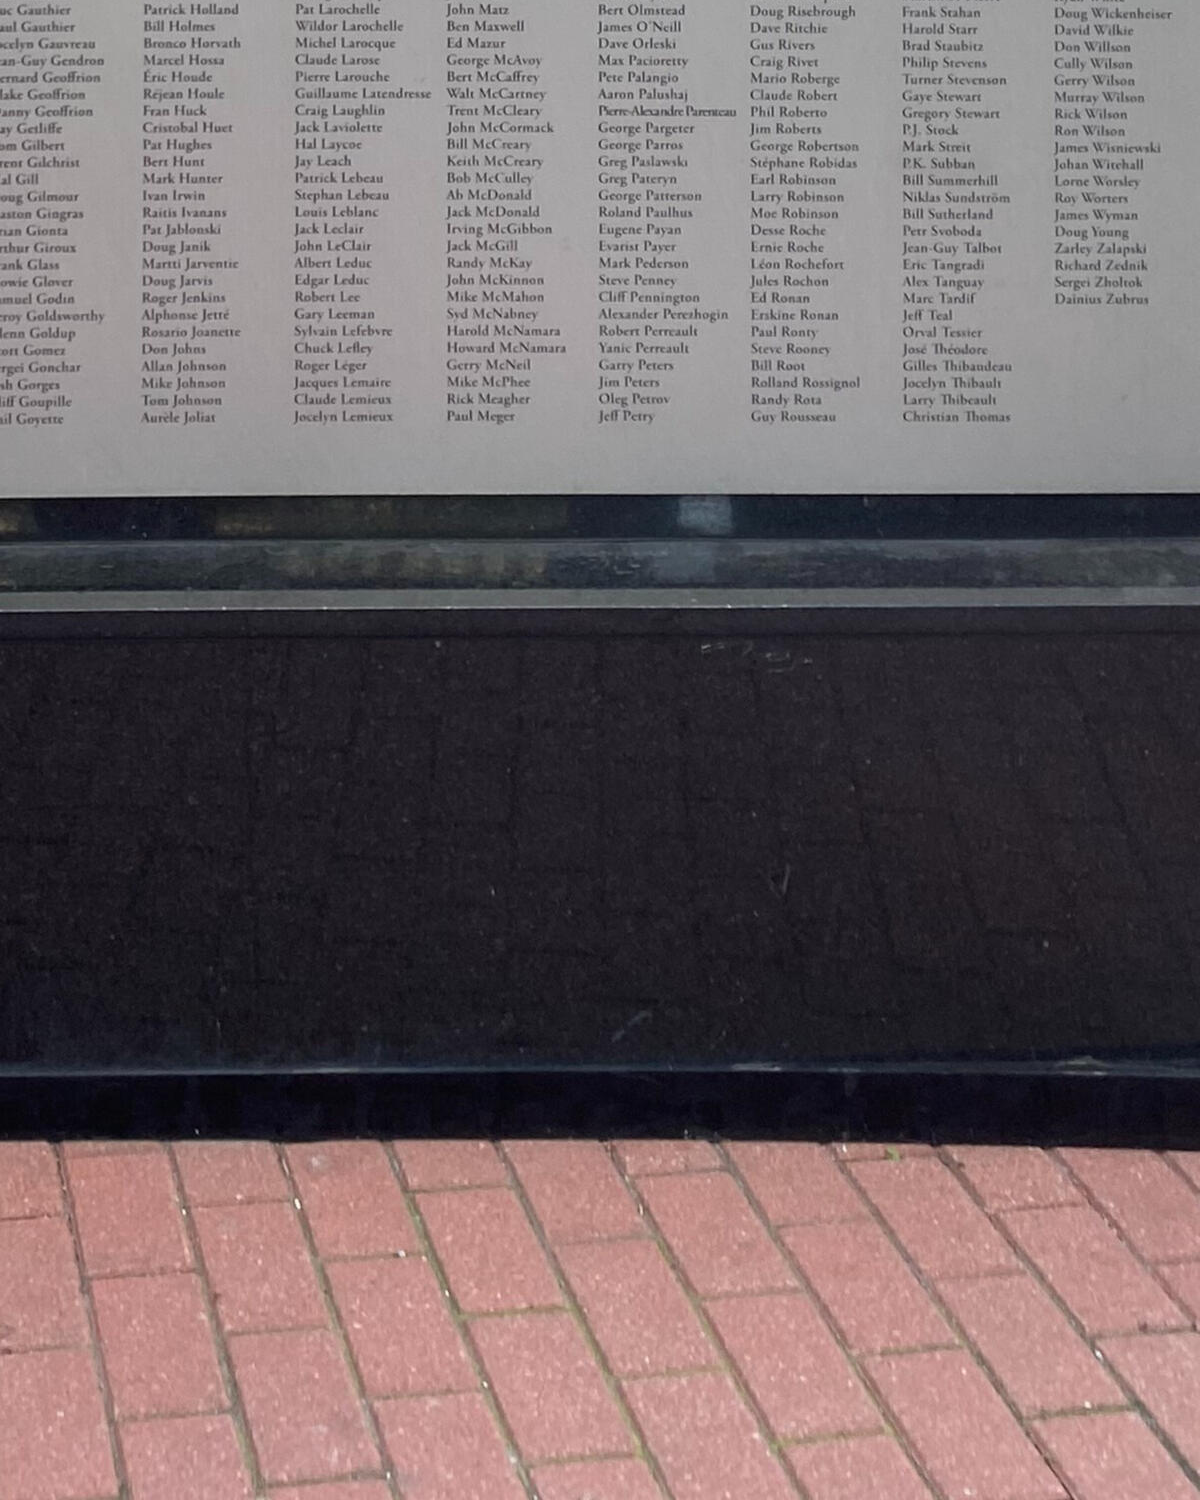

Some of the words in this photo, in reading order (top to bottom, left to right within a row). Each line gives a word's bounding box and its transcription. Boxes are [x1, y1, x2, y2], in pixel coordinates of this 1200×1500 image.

[598, 70, 623, 83] Pete
[627, 70, 679, 87] Palangio
[1054, 91, 1099, 109] Murray
[1101, 91, 1145, 103] Wilson
[294, 103, 329, 120] Craig
[332, 103, 386, 120] Laughlin
[483, 104, 541, 119] McCleary
[20, 138, 65, 152] Gilbert
[750, 189, 782, 205] Larry
[787, 189, 845, 203] Robinson
[1054, 258, 1102, 272] Richard
[1105, 258, 1148, 272] Zednik
[25, 308, 105, 324] Goldsworthy
[902, 376, 947, 391] Jocelyn
[951, 376, 1002, 389] Thibault
[293, 392, 337, 405] Claude
[340, 392, 392, 405] Lemieux
